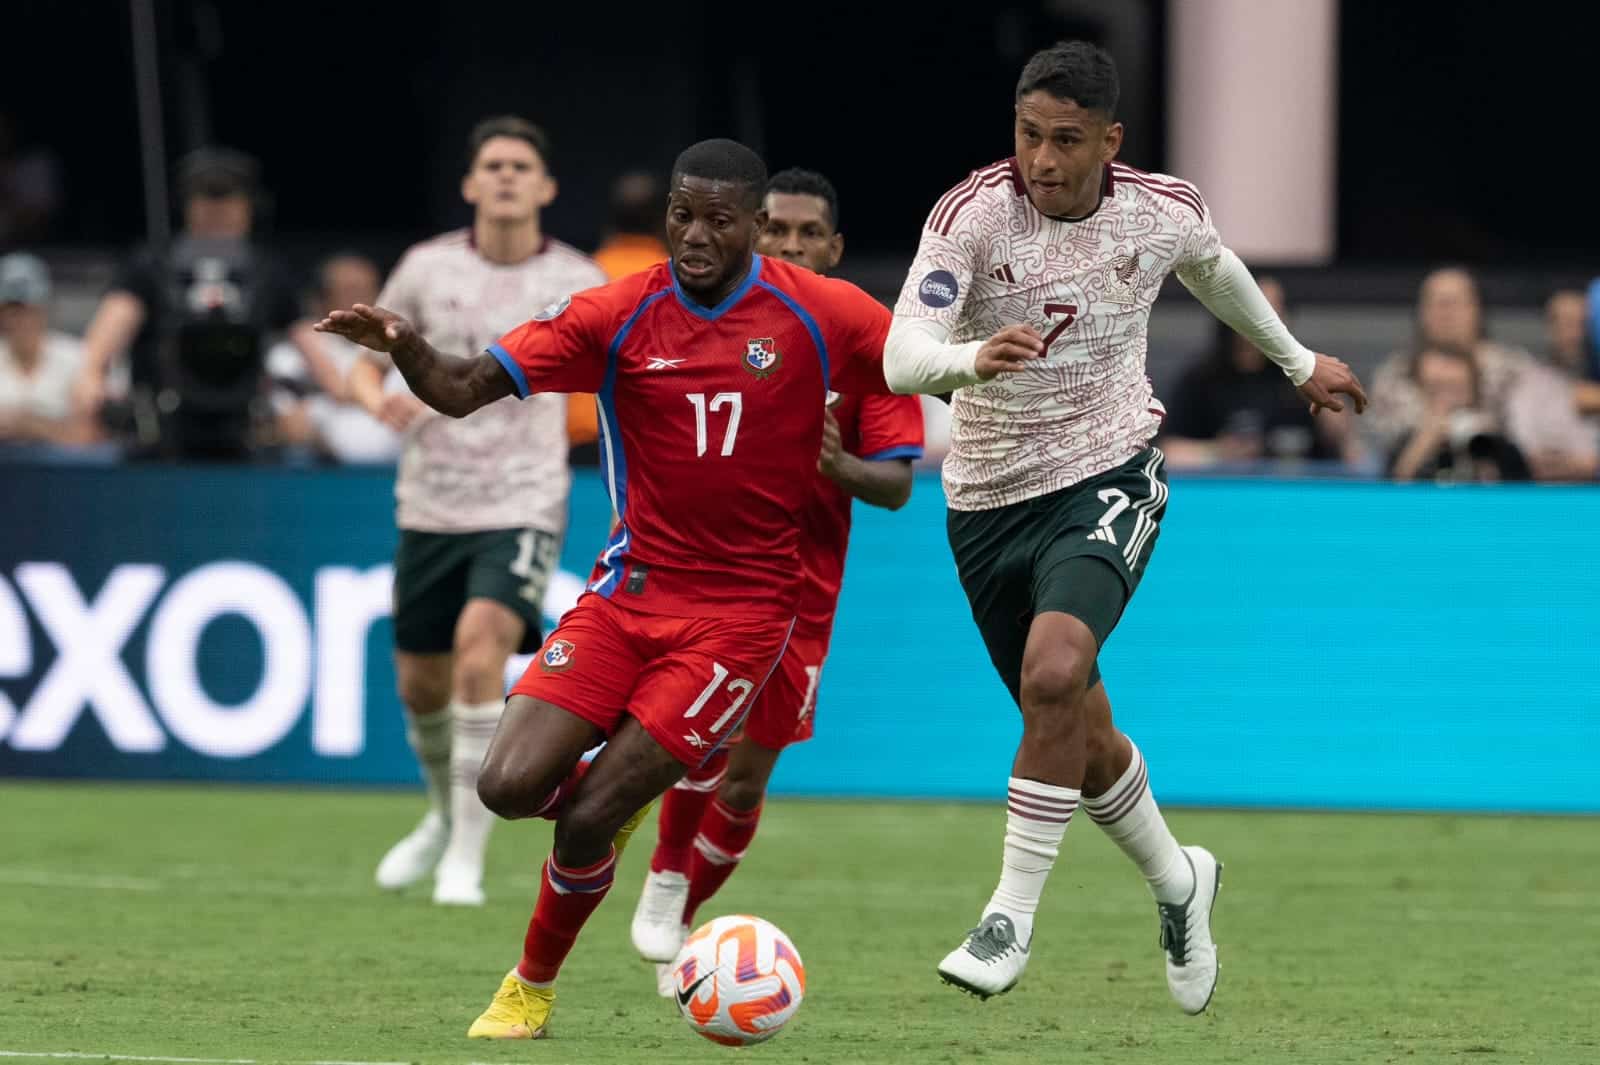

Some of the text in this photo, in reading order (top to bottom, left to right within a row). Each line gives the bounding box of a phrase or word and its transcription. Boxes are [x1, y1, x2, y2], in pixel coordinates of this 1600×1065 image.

[1038, 303, 1078, 358] 7
[685, 392, 743, 457] 17
[1097, 488, 1130, 526] 7
[683, 661, 754, 734] 17
